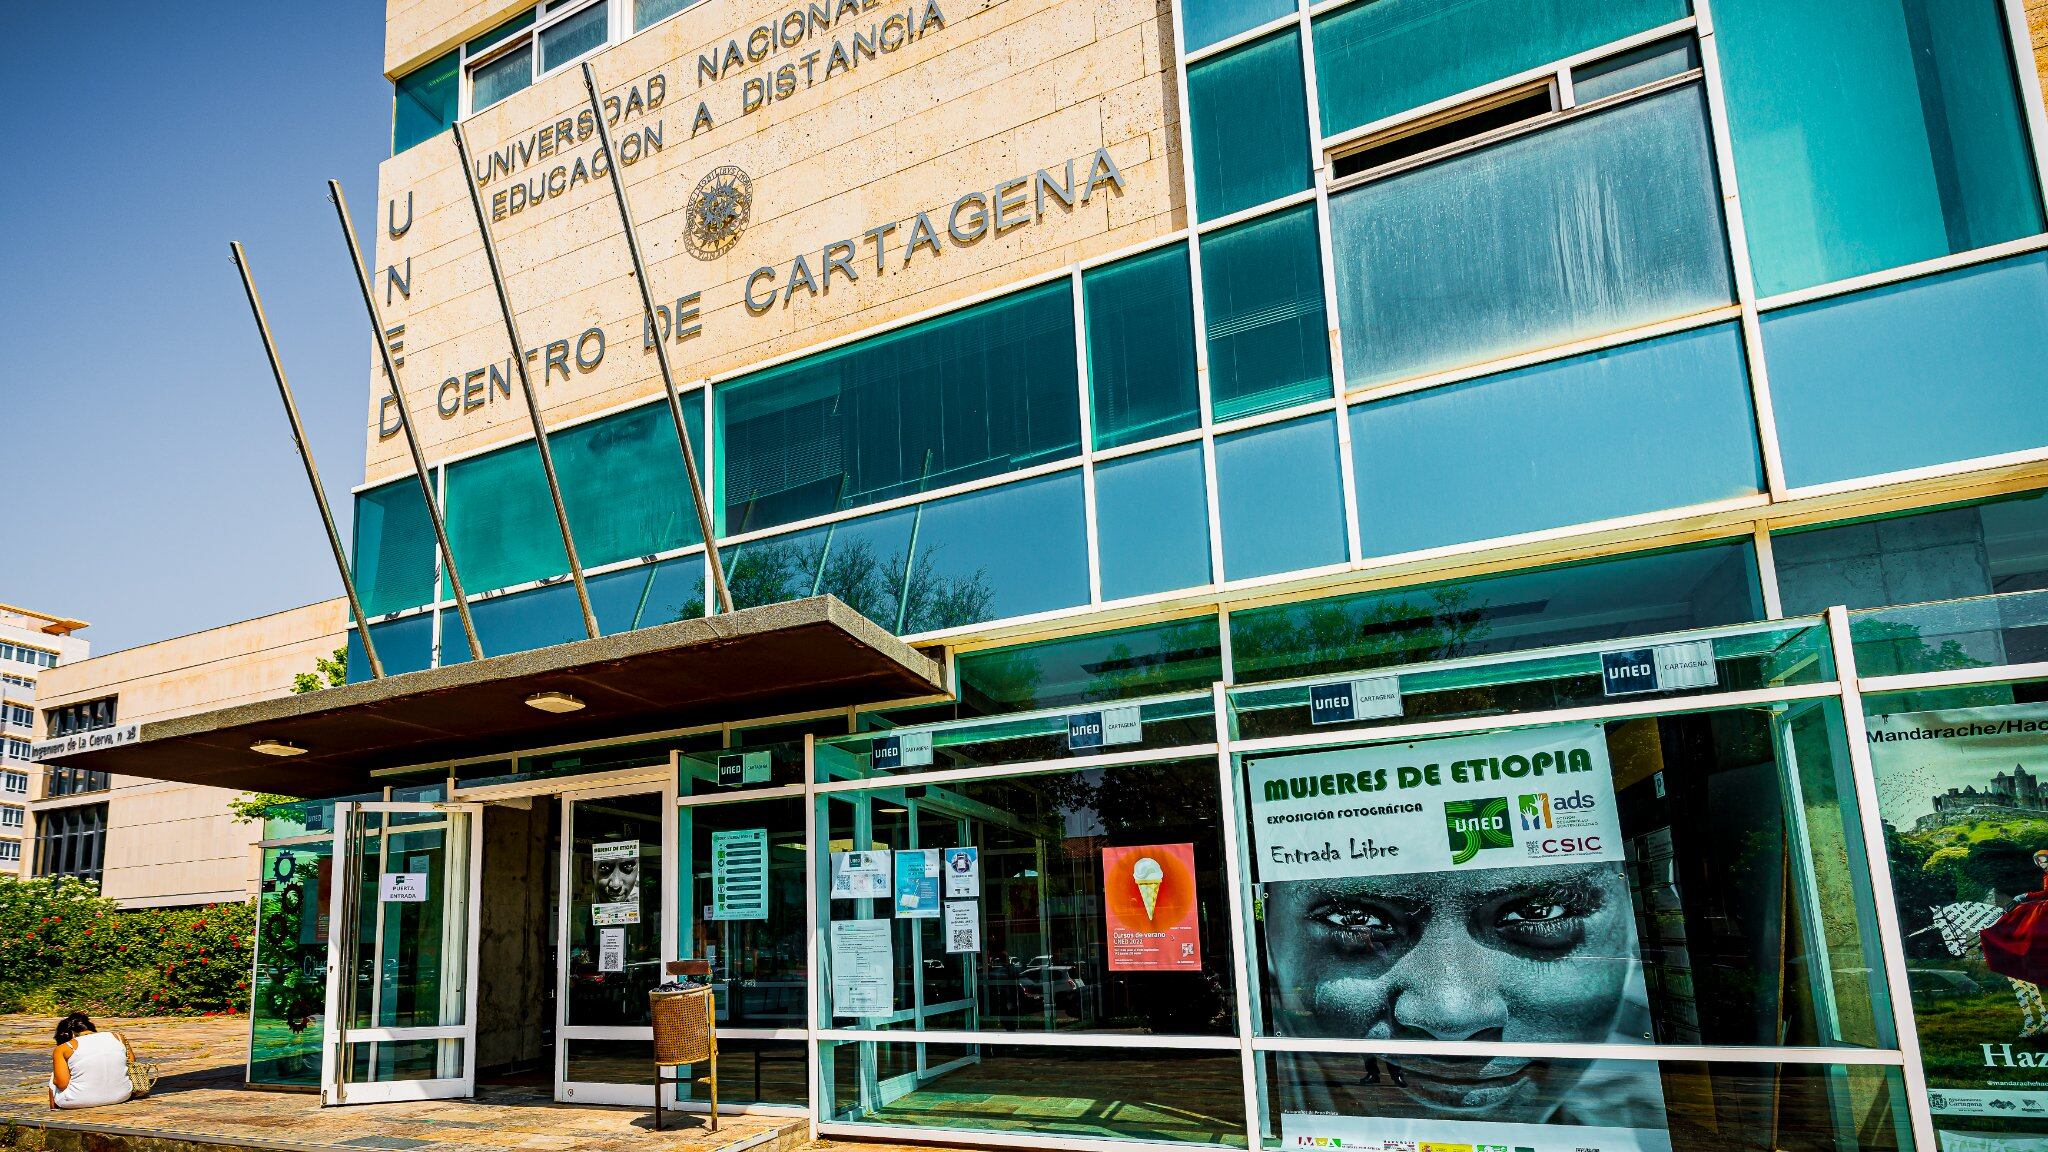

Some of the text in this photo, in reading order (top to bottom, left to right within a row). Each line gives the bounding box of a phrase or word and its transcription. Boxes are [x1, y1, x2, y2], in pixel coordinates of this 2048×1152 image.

[492, 119, 663, 223] EDUCACON
[691, 101, 714, 139] A
[743, 0, 946, 115] DISTANCIA
[477, 74, 666, 186] UNIVERSDAD
[643, 290, 703, 351] DE
[745, 147, 1127, 312] CARTAGENA
[1608, 659, 1708, 680] UNED CARTAGENA
[1315, 693, 1396, 710] UNED CARTAGENA
[1071, 721, 1137, 737] UNED CARTAGENA
[67, 737, 77, 750] de
[78, 737, 87, 748] La
[875, 747, 898, 758] UNED
[721, 765, 741, 775] UNED
[1264, 748, 1593, 802] MUJERES DE ETIOPIA
[1553, 790, 1596, 811] ads
[1267, 802, 1423, 825] EXPOSICIÓN FOTOGRÁFICA
[1455, 815, 1504, 833] UNED
[1271, 838, 1400, 866] Entrada Libre
[1542, 836, 1603, 853] CSIC
